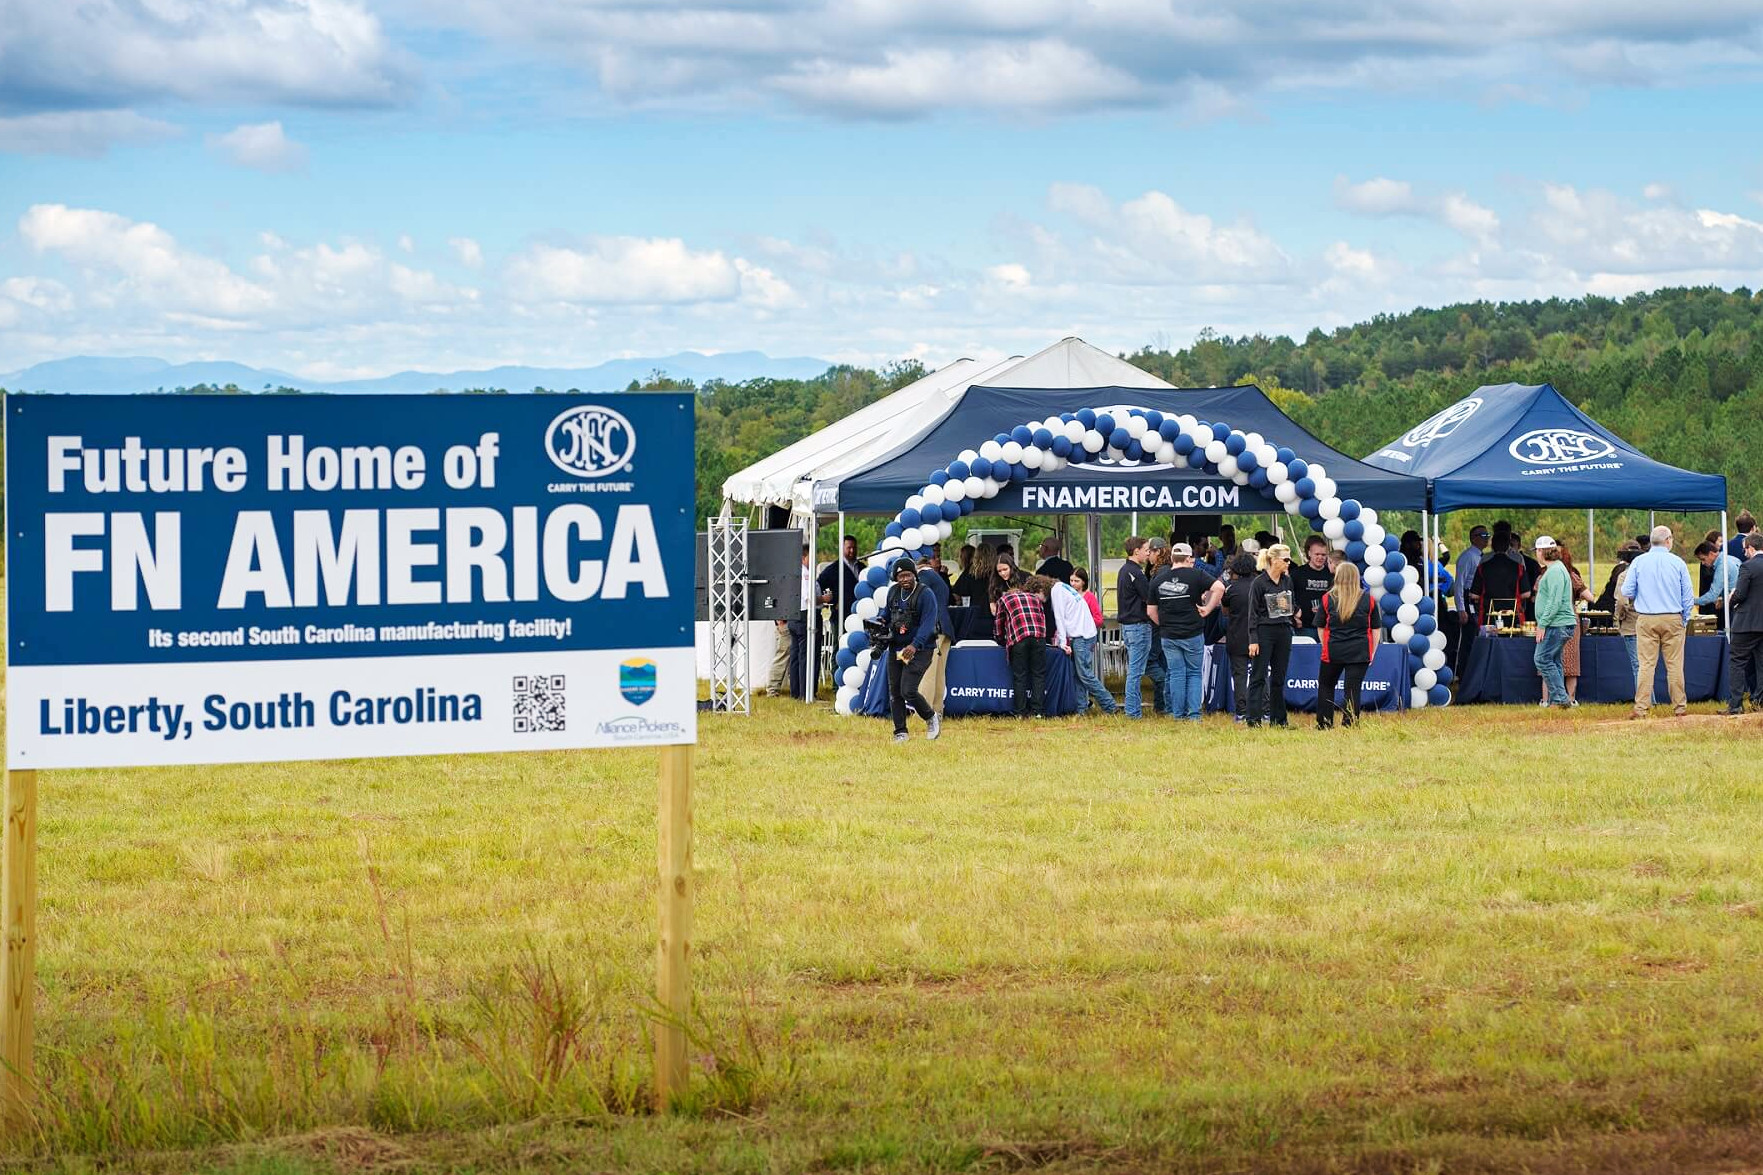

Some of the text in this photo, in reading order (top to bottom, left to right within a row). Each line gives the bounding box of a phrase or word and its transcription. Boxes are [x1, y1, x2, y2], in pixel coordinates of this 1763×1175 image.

[47, 432, 500, 494] Future Home of
[1521, 468, 1556, 476] CARRY
[1558, 465, 1579, 473] THE
[547, 482, 577, 493] CARRY
[579, 482, 596, 493] THE
[1022, 485, 1240, 509] FNAMERICA.COM
[44, 503, 670, 612] FN AMERICA
[148, 617, 572, 648] Its second South Carolina manufacturing facility!
[950, 687, 985, 697] CARRY
[987, 688, 1007, 698] THE
[1287, 679, 1319, 689] CARRY
[40, 687, 482, 741] Liberty, South Carolina
[638, 719, 680, 733] Pickens
